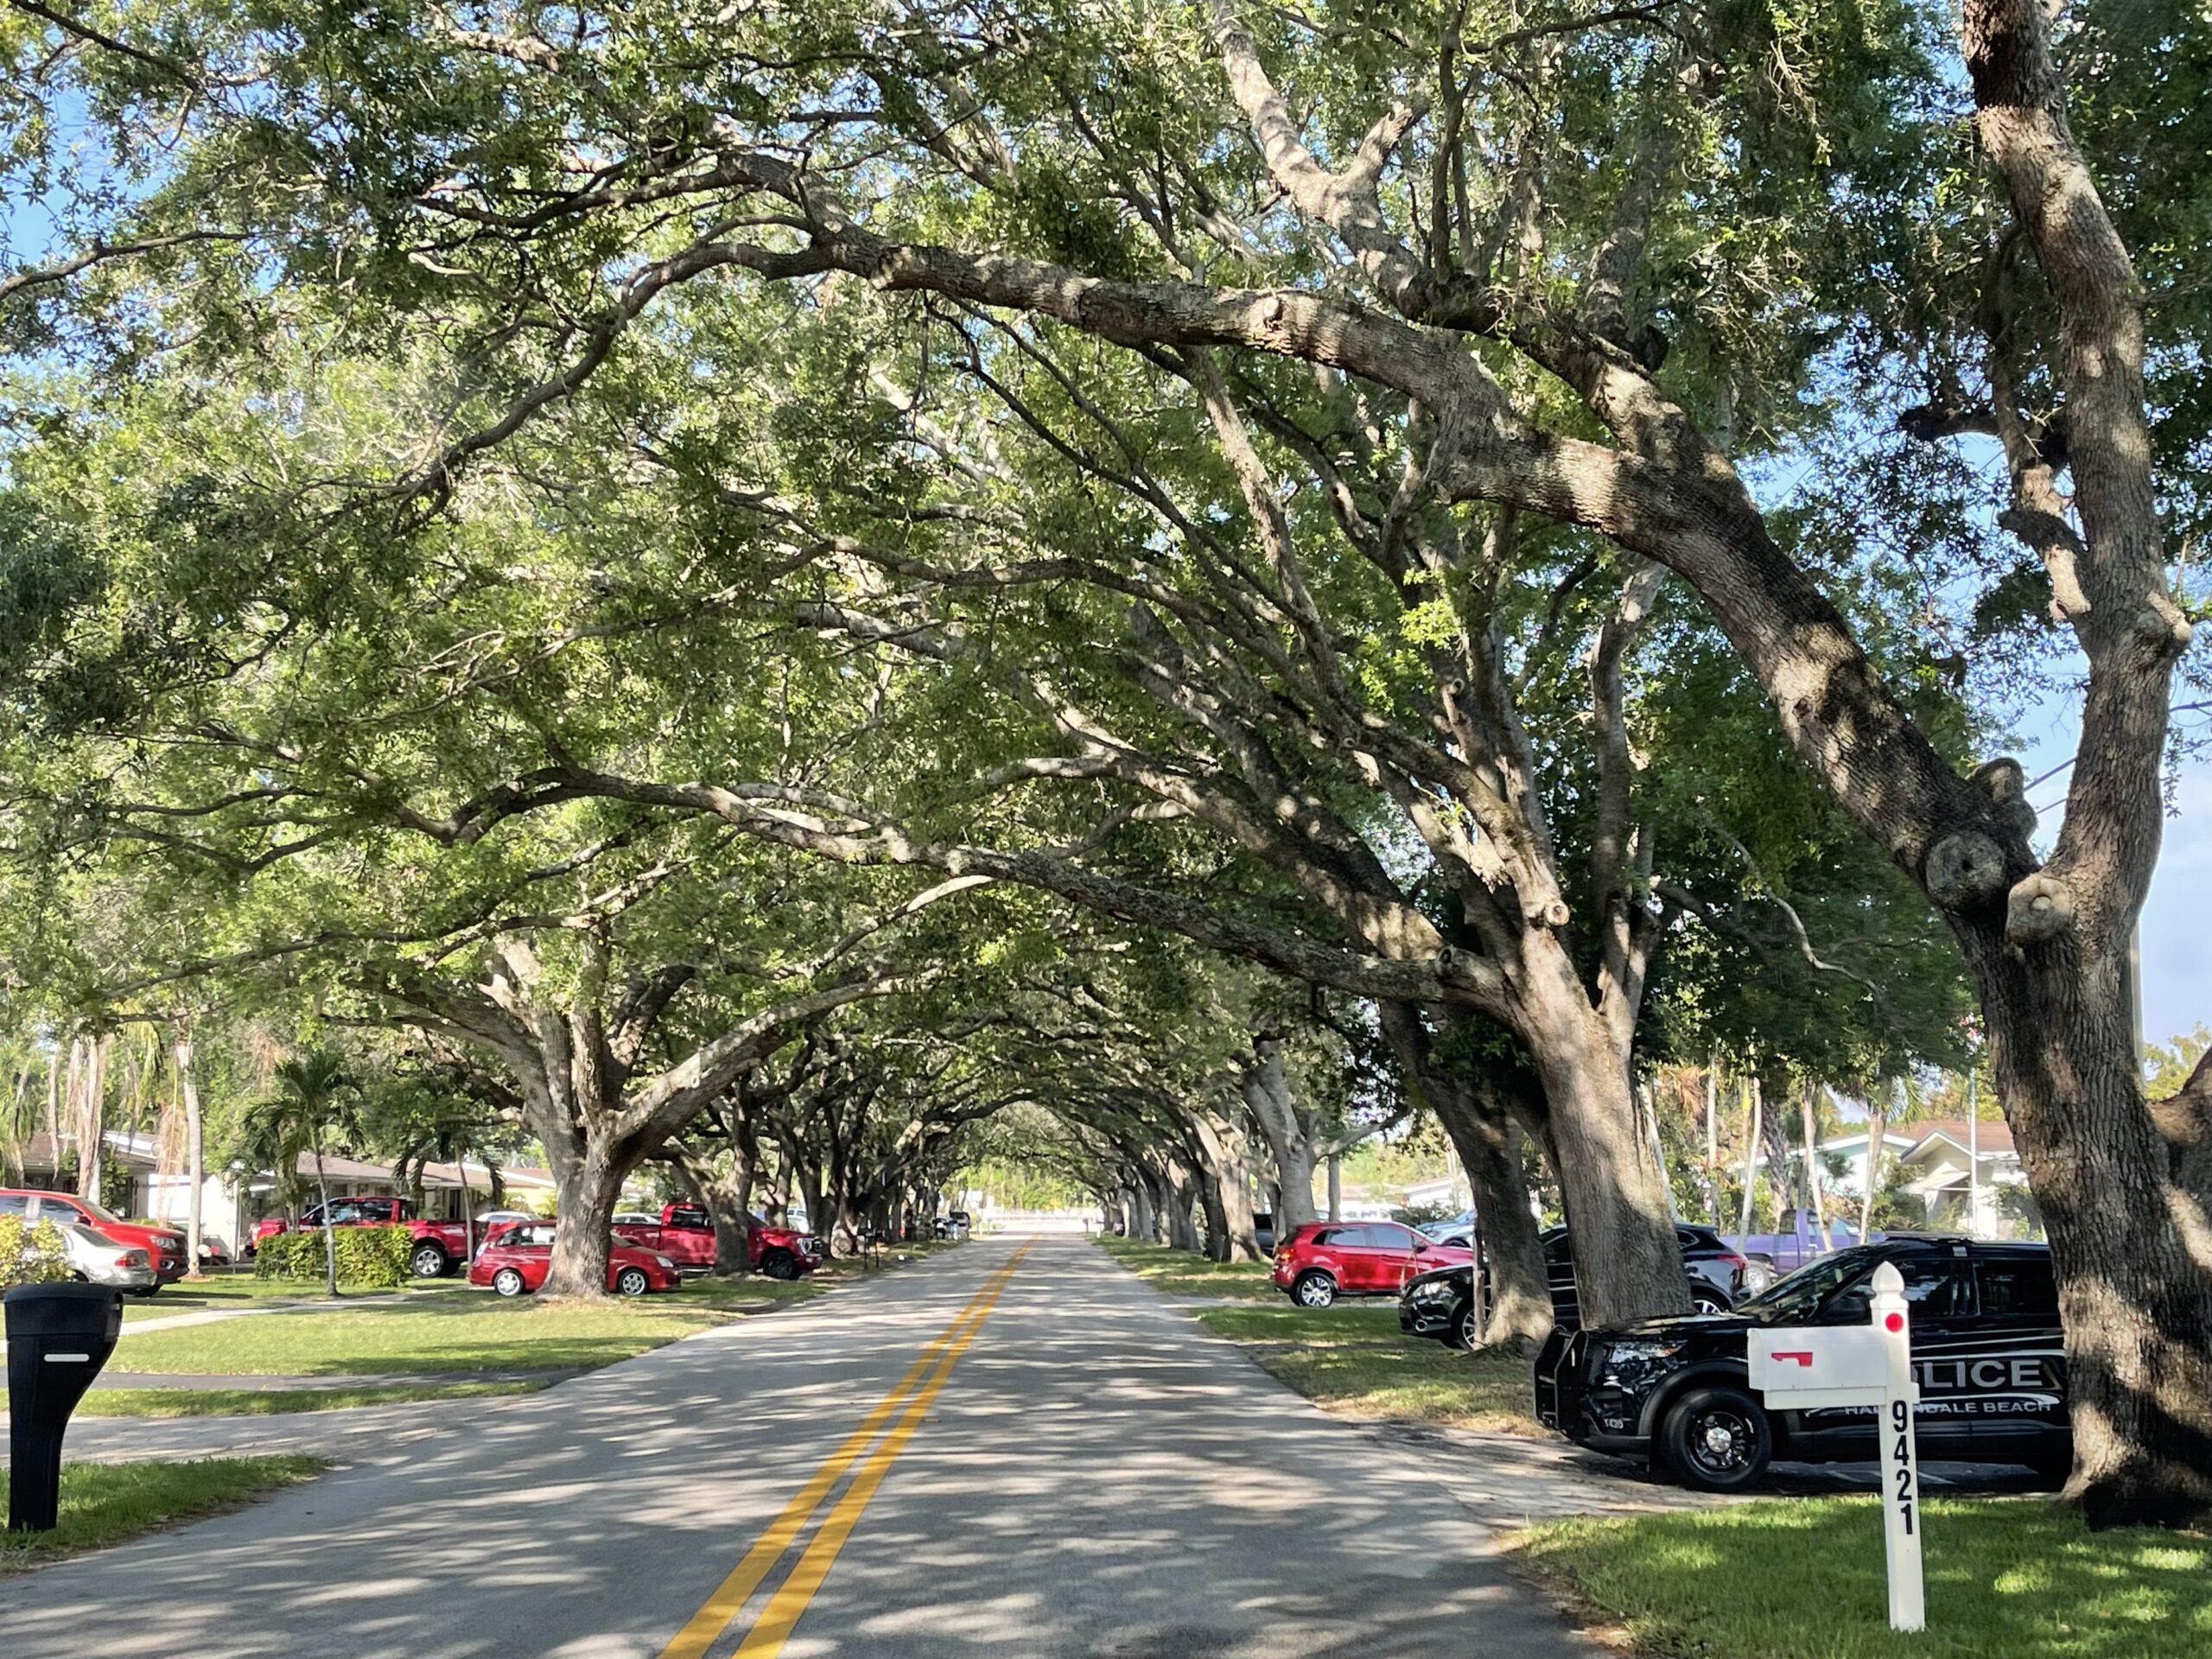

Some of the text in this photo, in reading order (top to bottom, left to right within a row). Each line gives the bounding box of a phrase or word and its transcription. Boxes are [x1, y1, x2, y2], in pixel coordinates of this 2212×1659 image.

[1911, 1359, 2044, 1388] LICE
[1846, 1402, 2052, 1414] HANDALE BEACH
[1892, 1400, 1913, 1535] 9421
